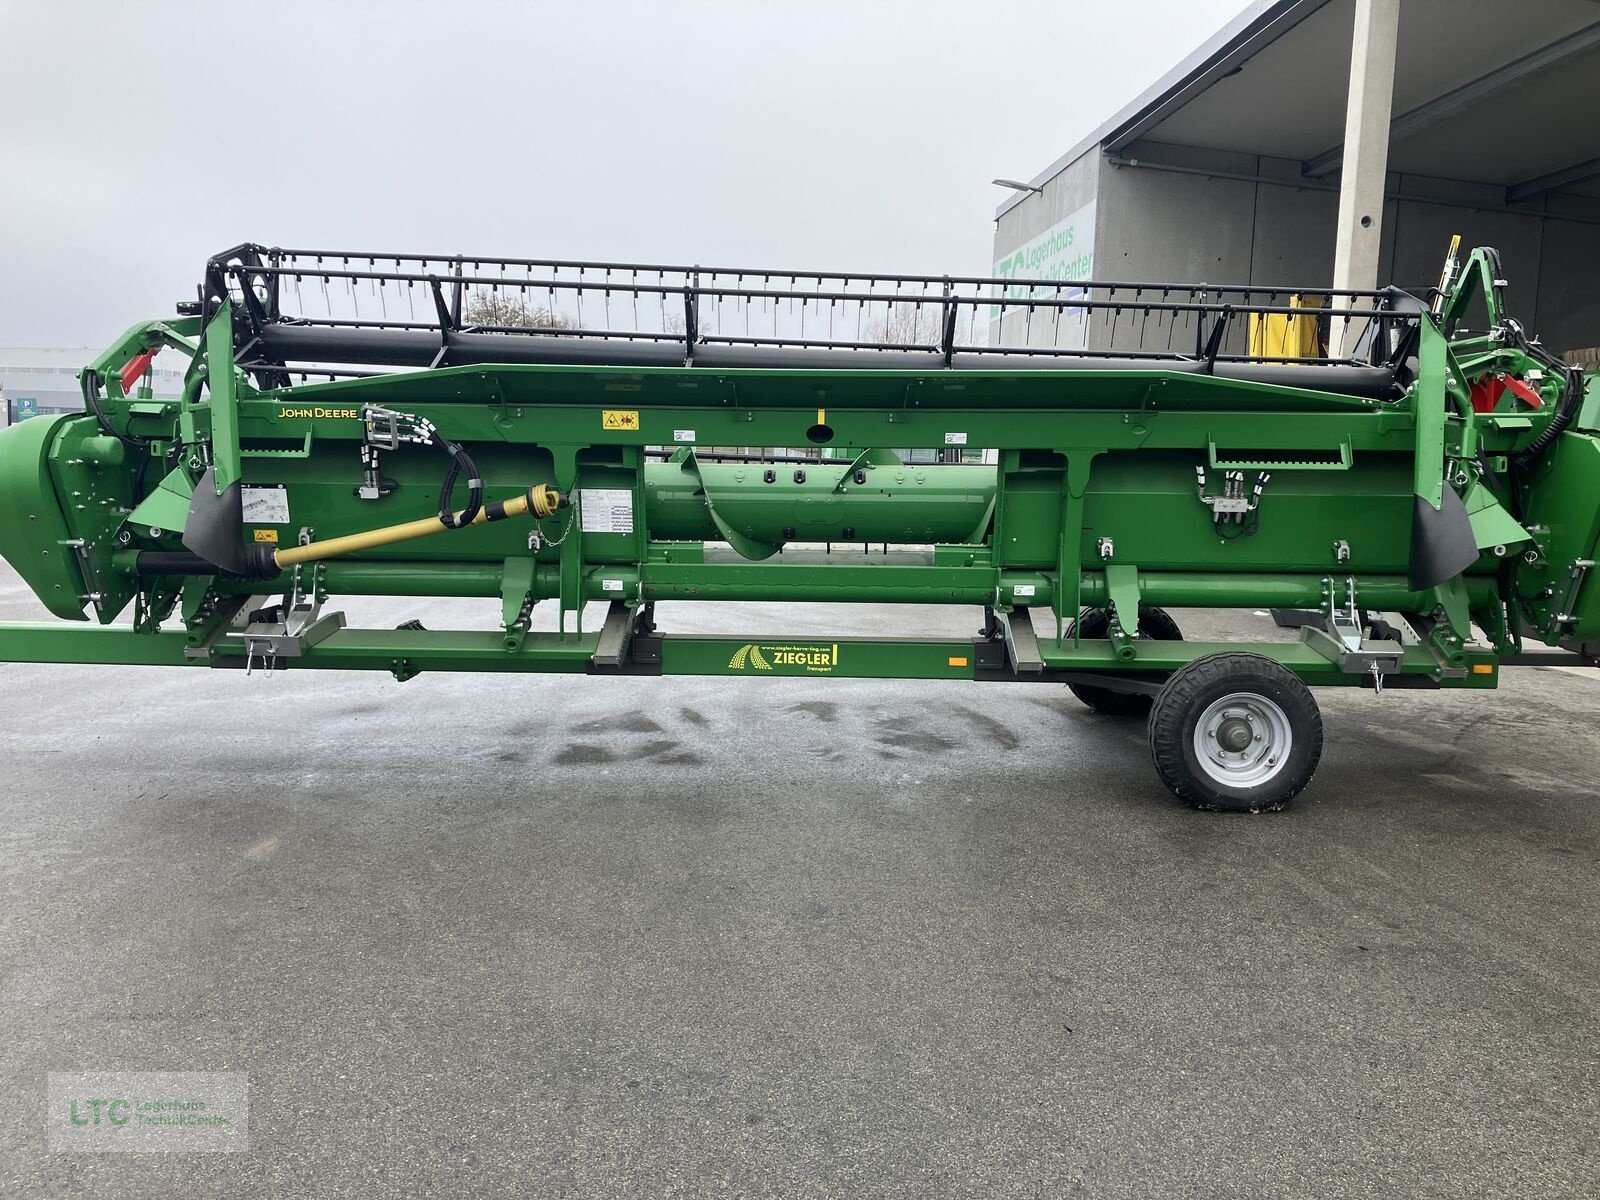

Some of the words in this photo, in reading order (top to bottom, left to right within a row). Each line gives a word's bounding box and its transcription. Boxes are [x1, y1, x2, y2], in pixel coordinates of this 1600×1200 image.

[1025, 226, 1074, 270] Lagerhaus
[278, 407, 313, 418] JOHN
[314, 407, 358, 418] DEERE
[773, 652, 831, 666] ZIEGLER
